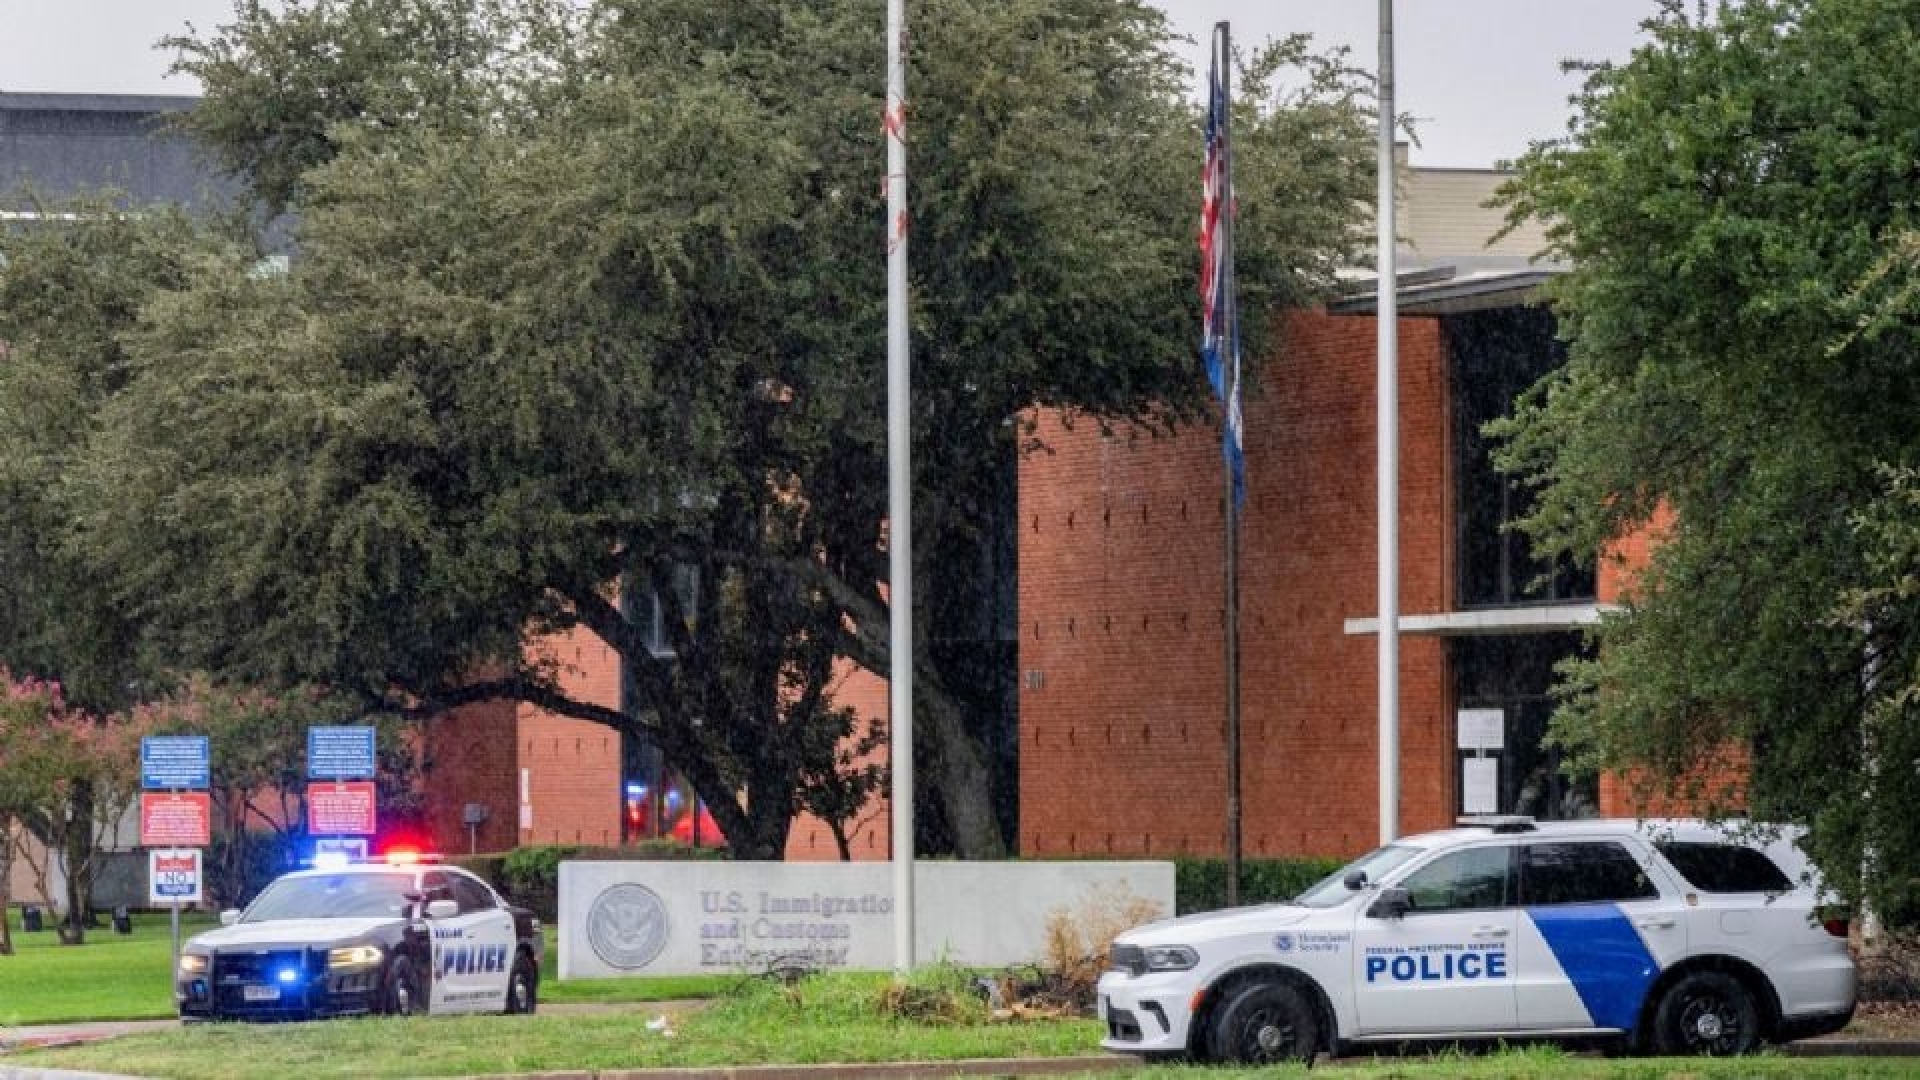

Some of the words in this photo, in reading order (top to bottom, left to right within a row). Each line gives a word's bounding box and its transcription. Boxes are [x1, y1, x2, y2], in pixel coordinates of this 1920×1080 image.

[700, 890, 748, 913] U.S.
[758, 891, 895, 917] Immigratio
[701, 918, 739, 938] and
[753, 918, 851, 939] Customs
[443, 943, 508, 975] POLICE
[1366, 952, 1507, 982] POLICE
